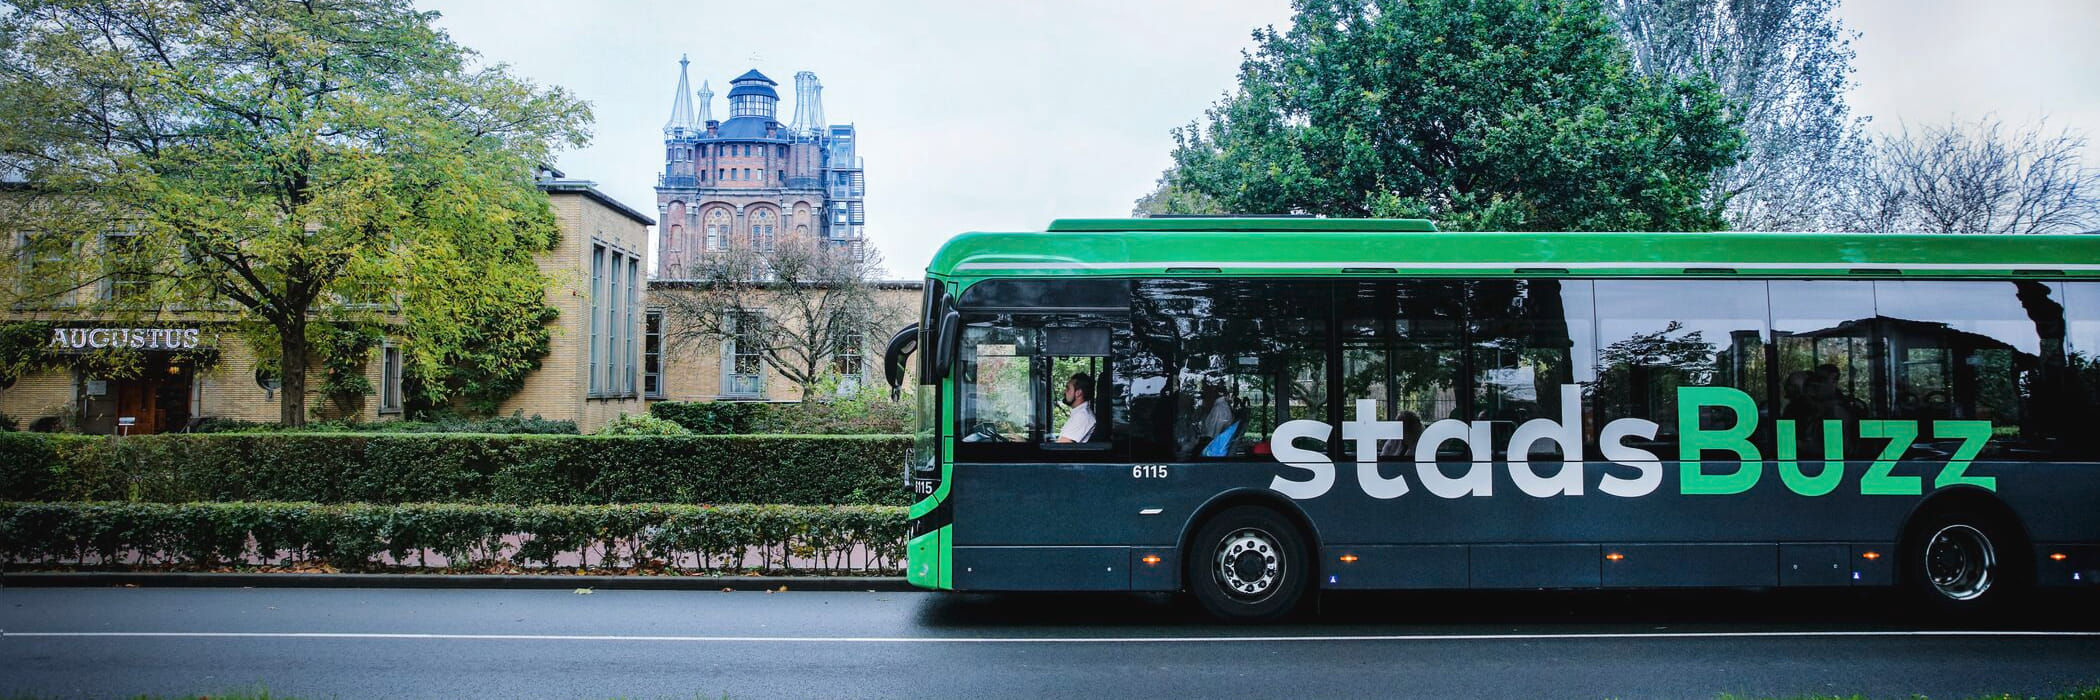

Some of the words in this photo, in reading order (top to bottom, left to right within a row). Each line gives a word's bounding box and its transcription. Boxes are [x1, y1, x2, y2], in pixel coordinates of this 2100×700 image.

[50, 328, 200, 349] AUGUSTUS
[1269, 384, 1997, 499] stadsBuzz
[1133, 465, 1168, 478] 6115
